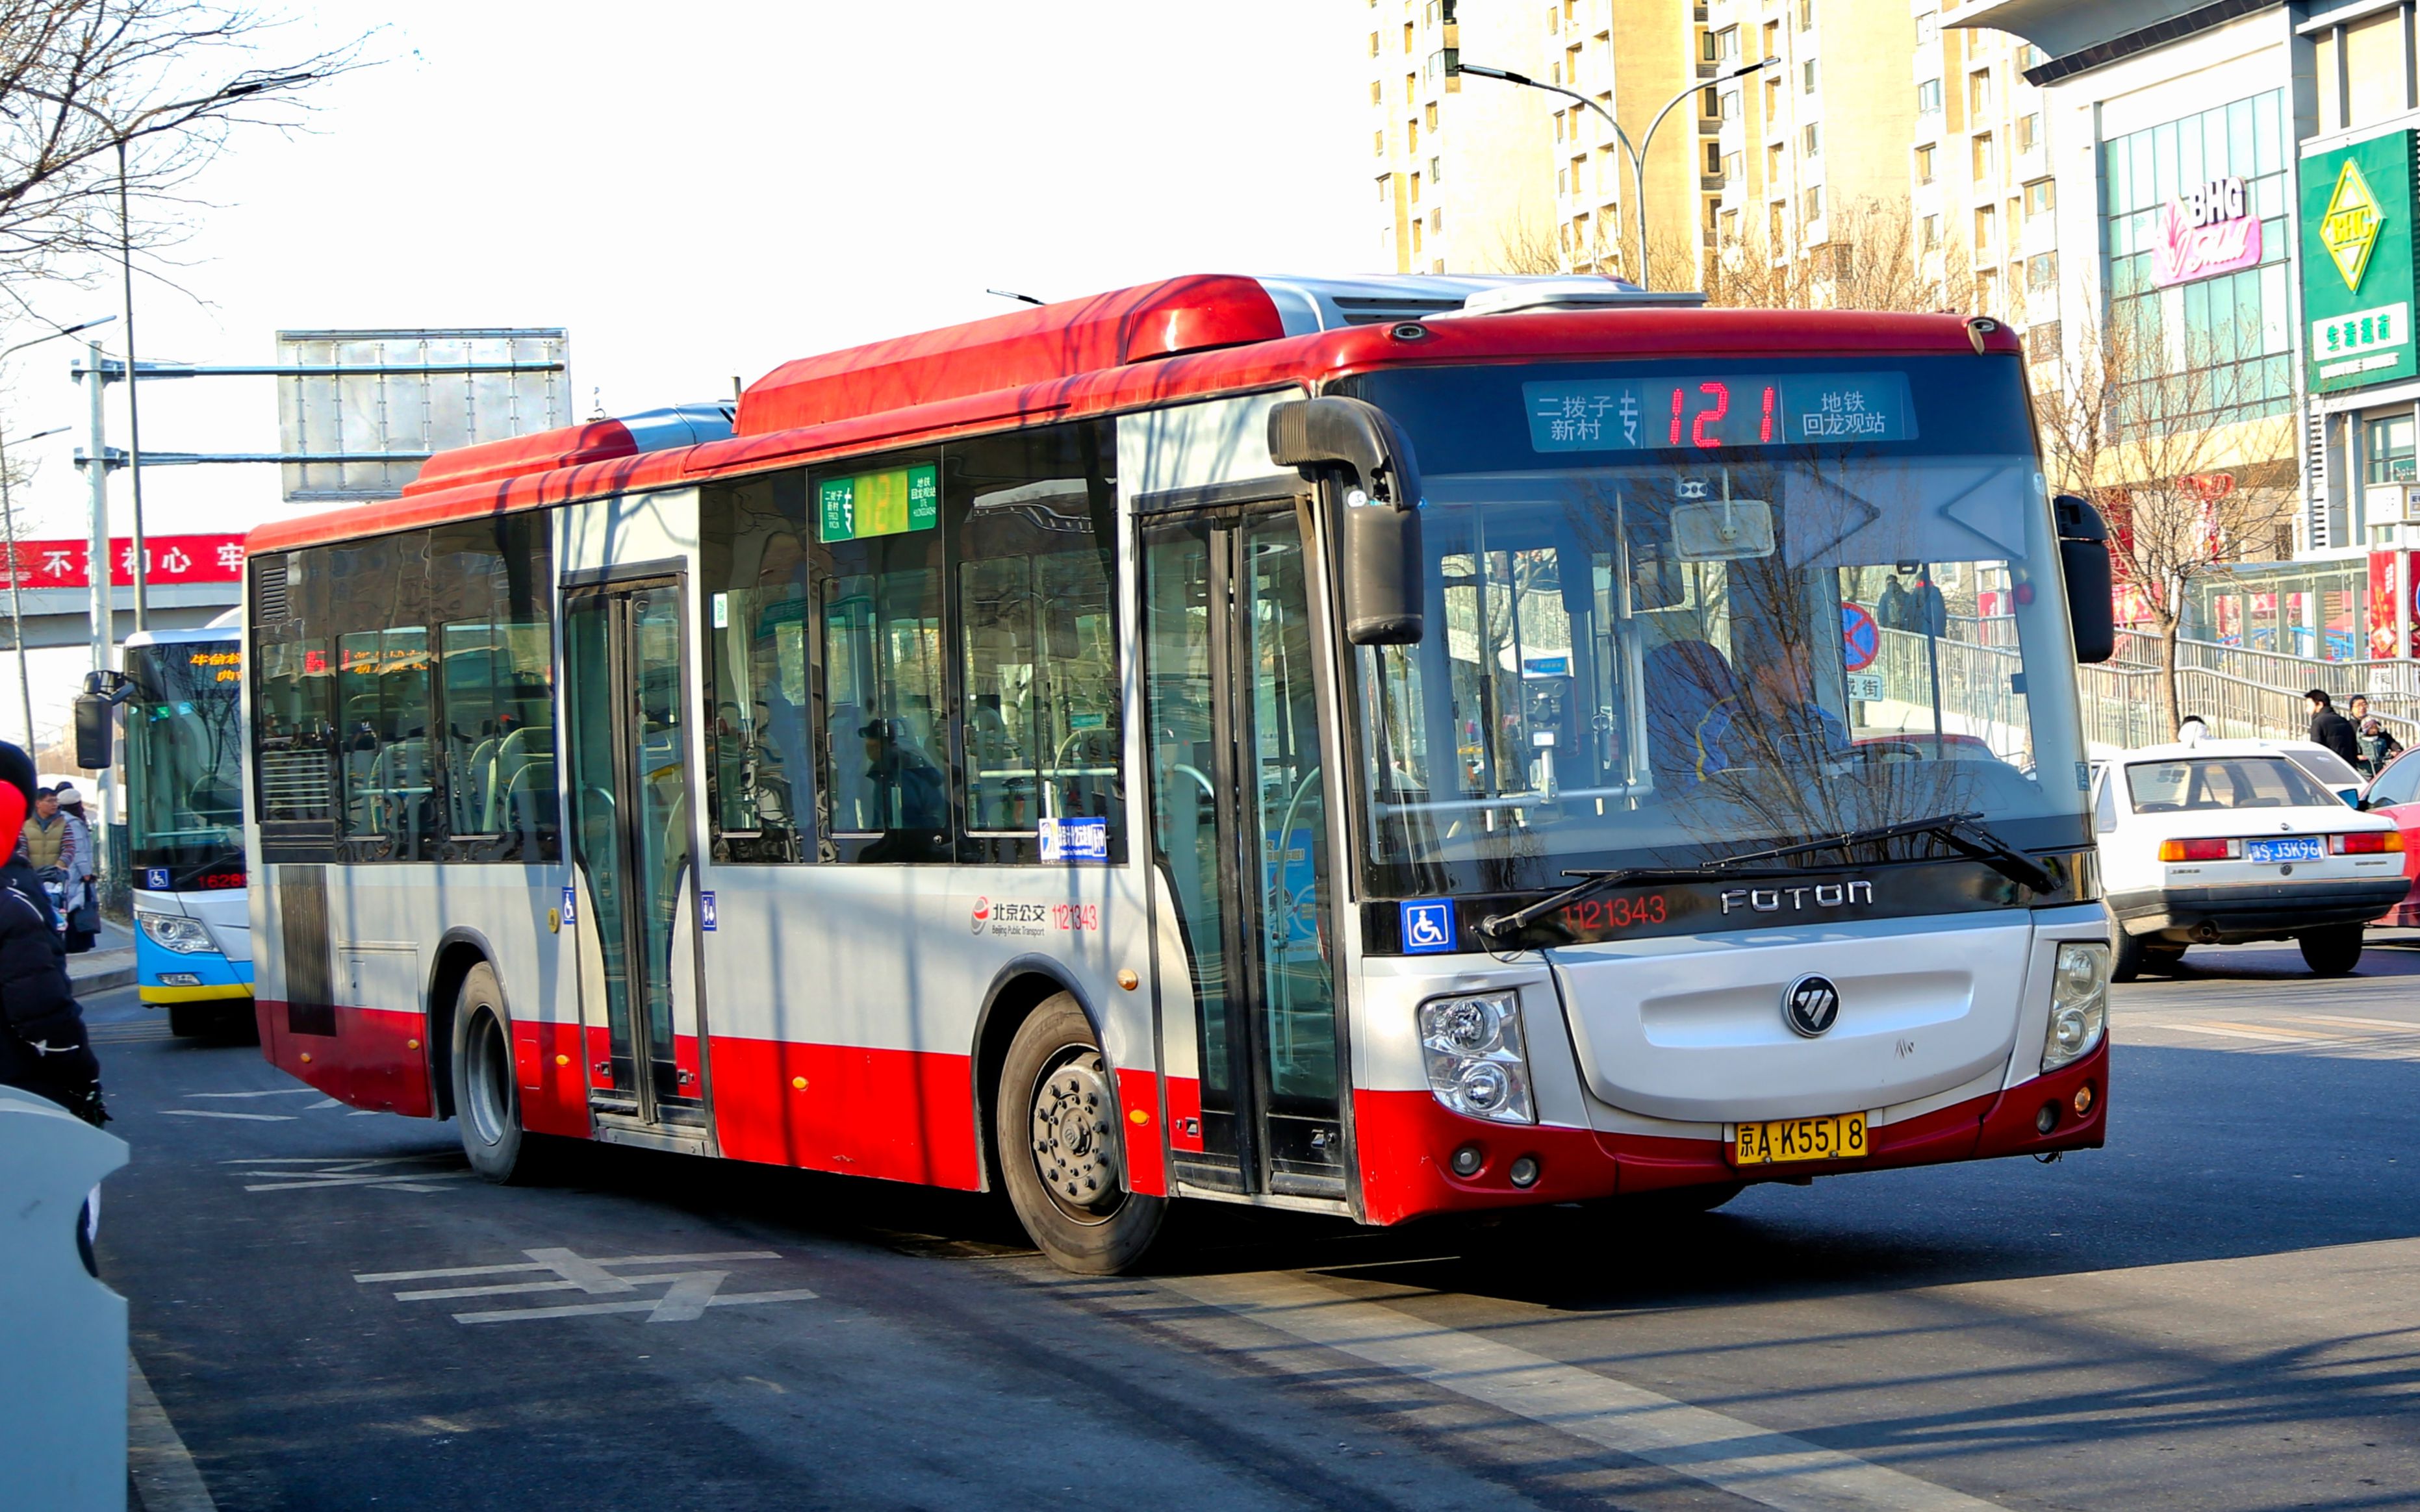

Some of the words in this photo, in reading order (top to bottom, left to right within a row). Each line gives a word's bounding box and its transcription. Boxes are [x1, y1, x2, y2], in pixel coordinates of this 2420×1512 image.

[2189, 177, 2246, 229] BHG
[1537, 395, 1613, 419] 二拨子
[1670, 382, 1774, 447] 121
[1820, 392, 1865, 412] 地铁
[1551, 420, 1601, 440] 新村
[1803, 412, 1886, 435] 回龙观站
[42, 546, 192, 578] 不初心
[1722, 881, 1873, 914] FOTON
[993, 903, 1045, 922] 北京公交
[1052, 904, 1097, 930] 1121343
[1561, 895, 1666, 930] 1121343
[992, 925, 1007, 937] Beijing
[1008, 926, 1021, 935] Public
[1022, 926, 1045, 937] Transport
[1740, 1118, 1863, 1157] 京A·K5518
